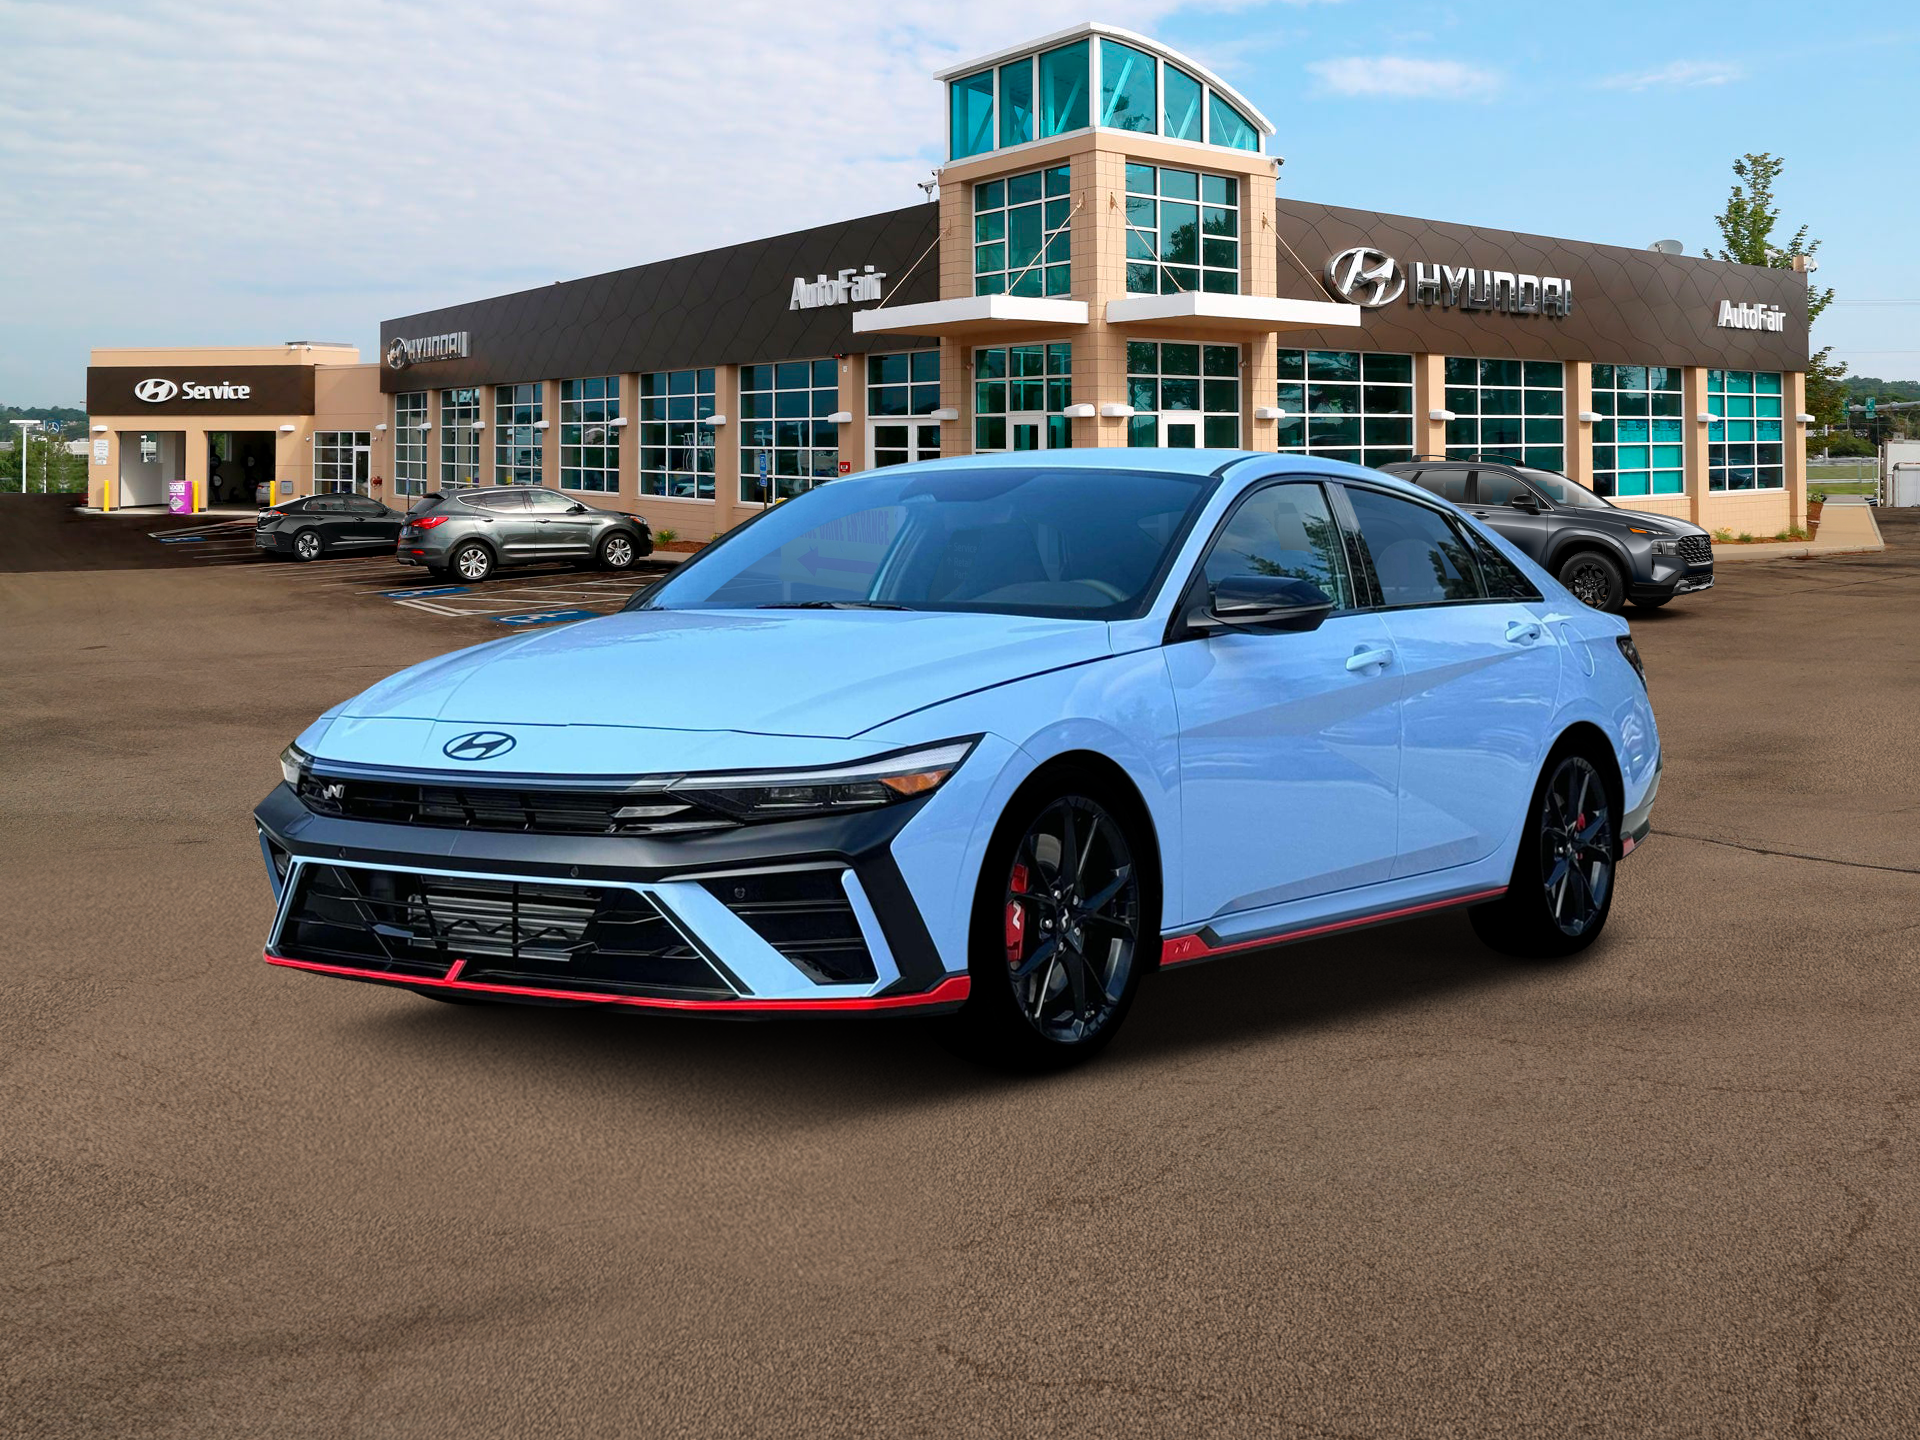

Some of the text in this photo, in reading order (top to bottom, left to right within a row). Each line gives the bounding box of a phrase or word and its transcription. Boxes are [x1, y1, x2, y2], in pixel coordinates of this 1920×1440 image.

[789, 265, 887, 310] AutoFair
[1408, 261, 1573, 317] HYUNDAI
[1717, 299, 1786, 332] AutoFair
[407, 331, 470, 362] HYUNDAI
[181, 381, 250, 400] Service
[846, 509, 889, 546] ENTRANCE
[953, 542, 978, 554] Service
[953, 569, 970, 579] Part
